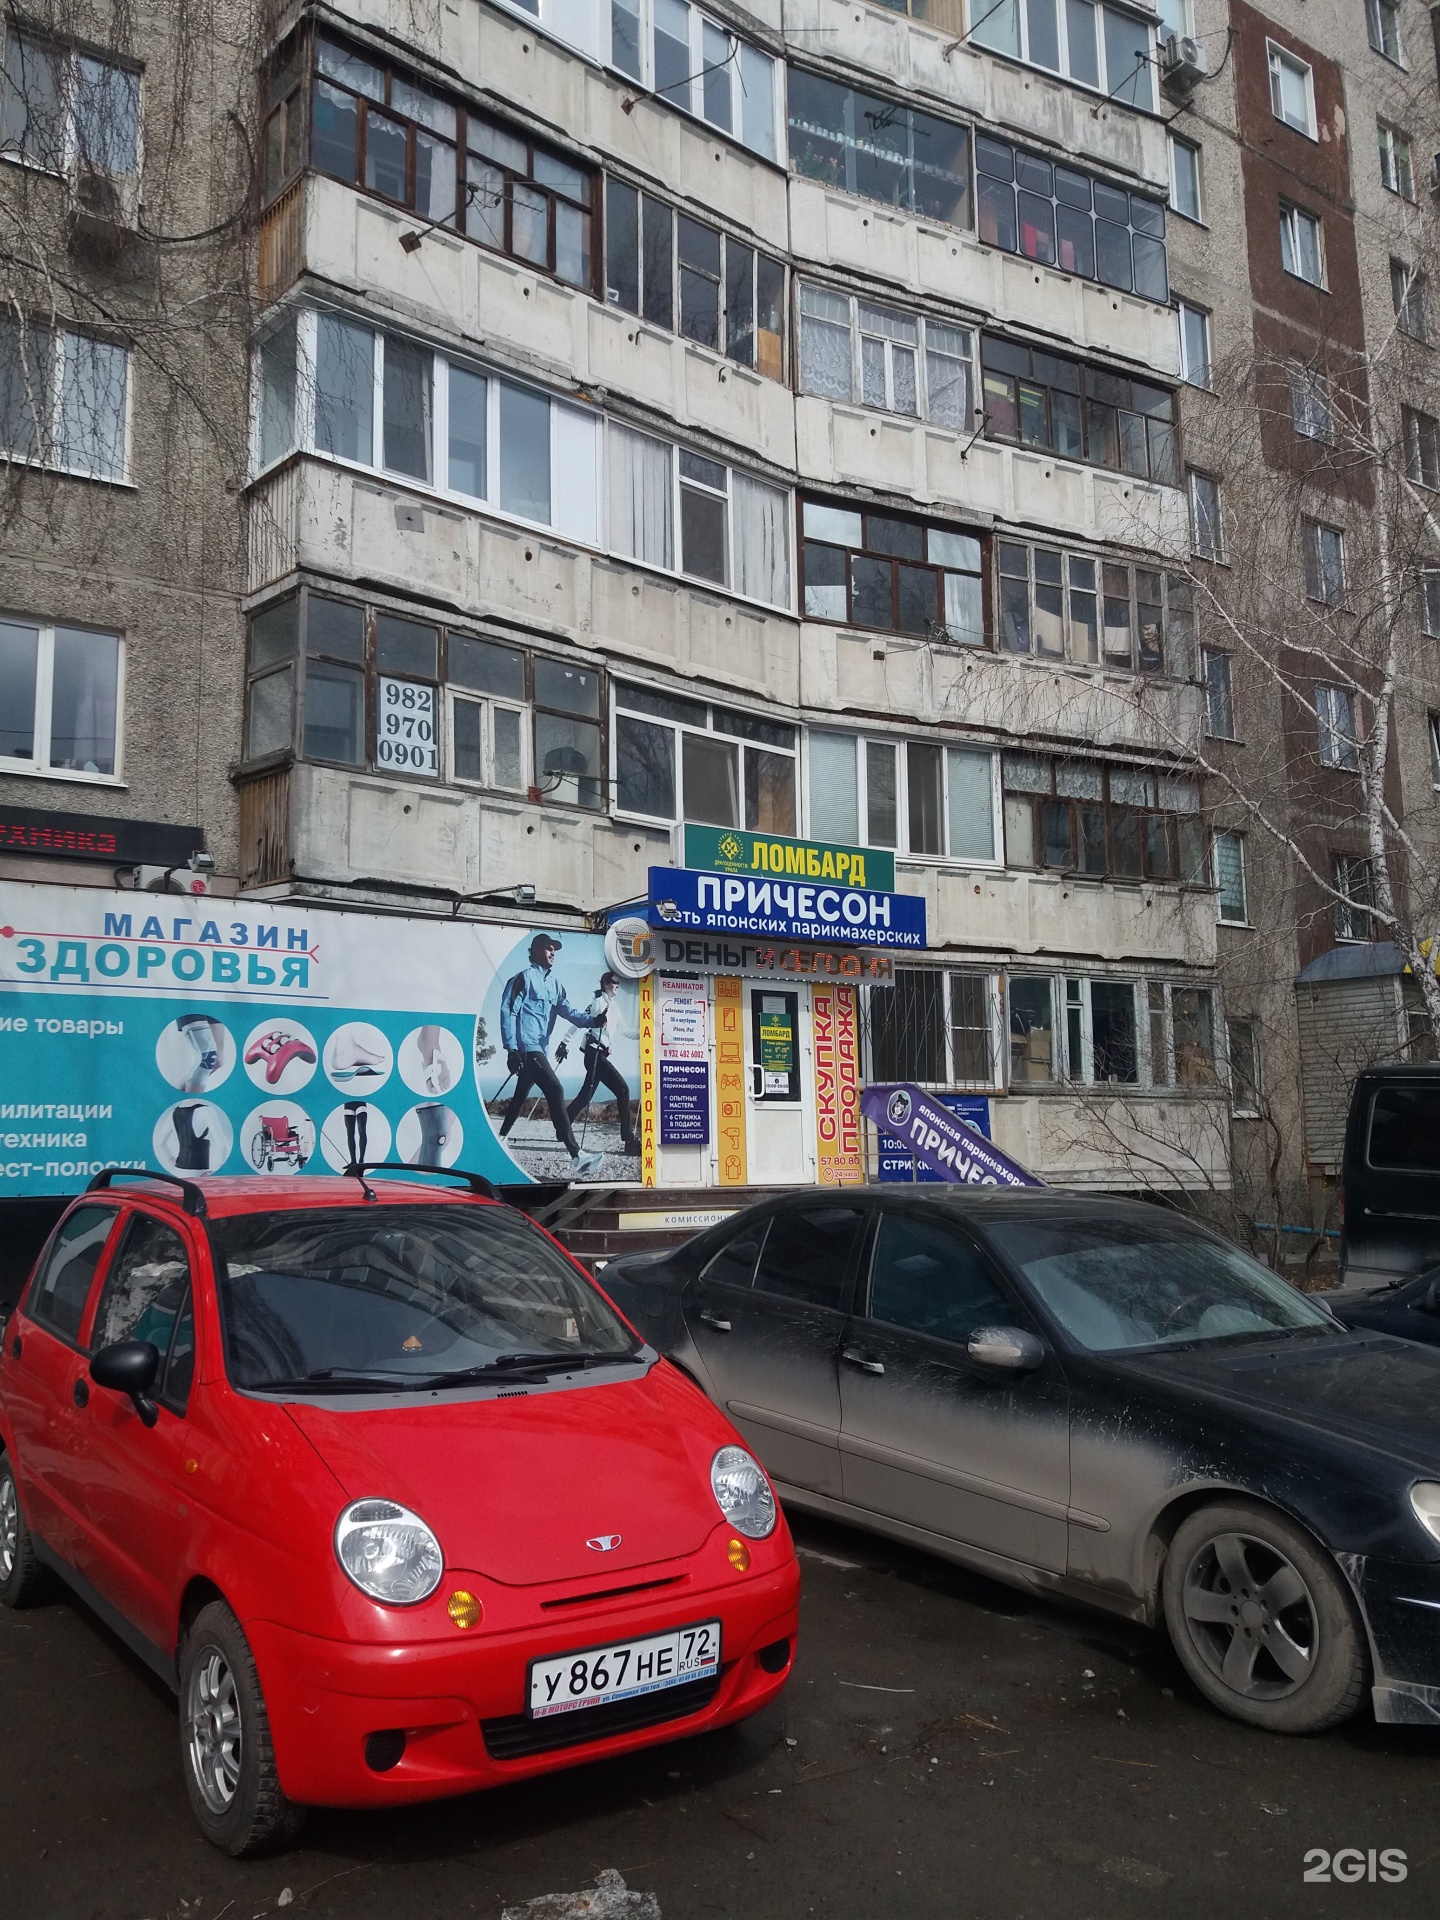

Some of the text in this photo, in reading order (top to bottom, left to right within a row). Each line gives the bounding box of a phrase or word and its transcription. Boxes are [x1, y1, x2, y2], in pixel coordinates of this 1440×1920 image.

[386, 684, 431, 712] 982
[386, 713, 431, 741] 970
[379, 740, 437, 770] 0901
[751, 842, 866, 887] ЛОМБАРД
[698, 876, 891, 927] ПРИЧЕСОН
[104, 912, 308, 951] МАГАЗИН
[706, 914, 787, 933] японских
[792, 921, 920, 945] парикмахерских
[16, 938, 309, 988] ЗДОРОВЬЯ
[662, 981, 704, 991] REANIMATOR
[674, 997, 693, 1005] РЕМОНТ
[35, 1018, 124, 1039] товары
[762, 1028, 790, 1039] ЛОМБАРД
[662, 1065, 706, 1075] причесон
[814, 997, 836, 1141] СКУПКА
[837, 986, 858, 1153] ПРОДАЖА
[918, 1104, 961, 1142] японская
[821, 1156, 860, 1166] 57 80 80
[683, 1629, 710, 1659] 72
[679, 1657, 700, 1671] RUS
[548, 1701, 577, 1714] МОТОРС
[579, 1695, 600, 1707] ГРУПП
